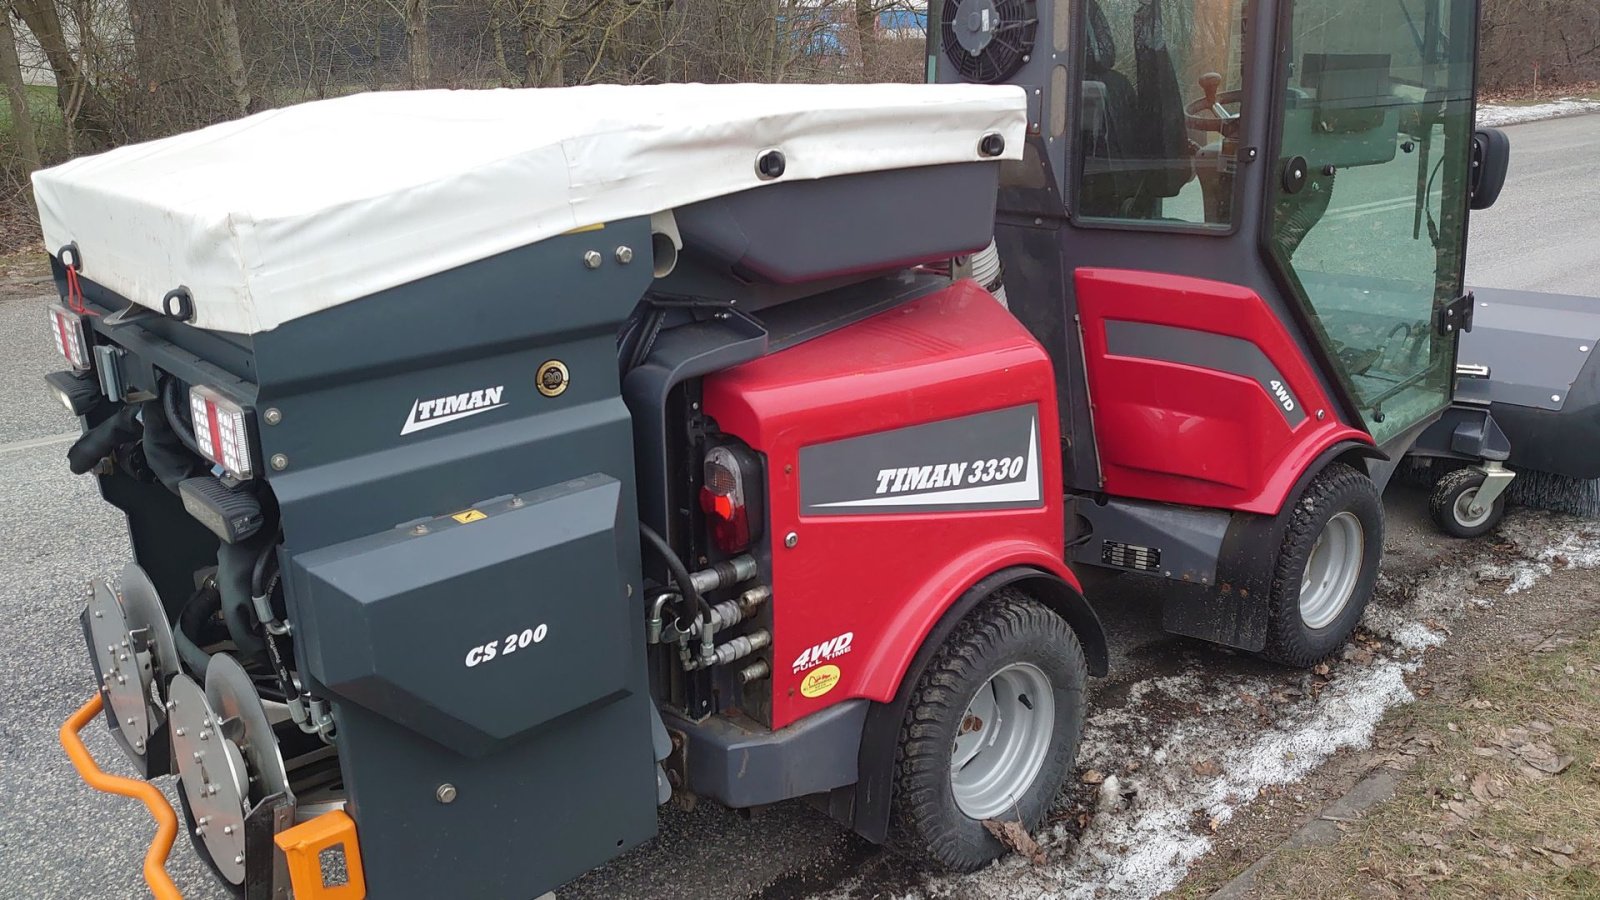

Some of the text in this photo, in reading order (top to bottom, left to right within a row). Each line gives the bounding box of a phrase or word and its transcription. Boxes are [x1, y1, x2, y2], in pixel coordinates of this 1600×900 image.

[417, 385, 504, 421] TIMAN
[1269, 379, 1295, 412] 4WD
[875, 455, 1024, 494] TIMAN 3330
[465, 623, 548, 668] CS 200
[792, 631, 853, 668] 4WD
[793, 646, 852, 675] FULL TIME
